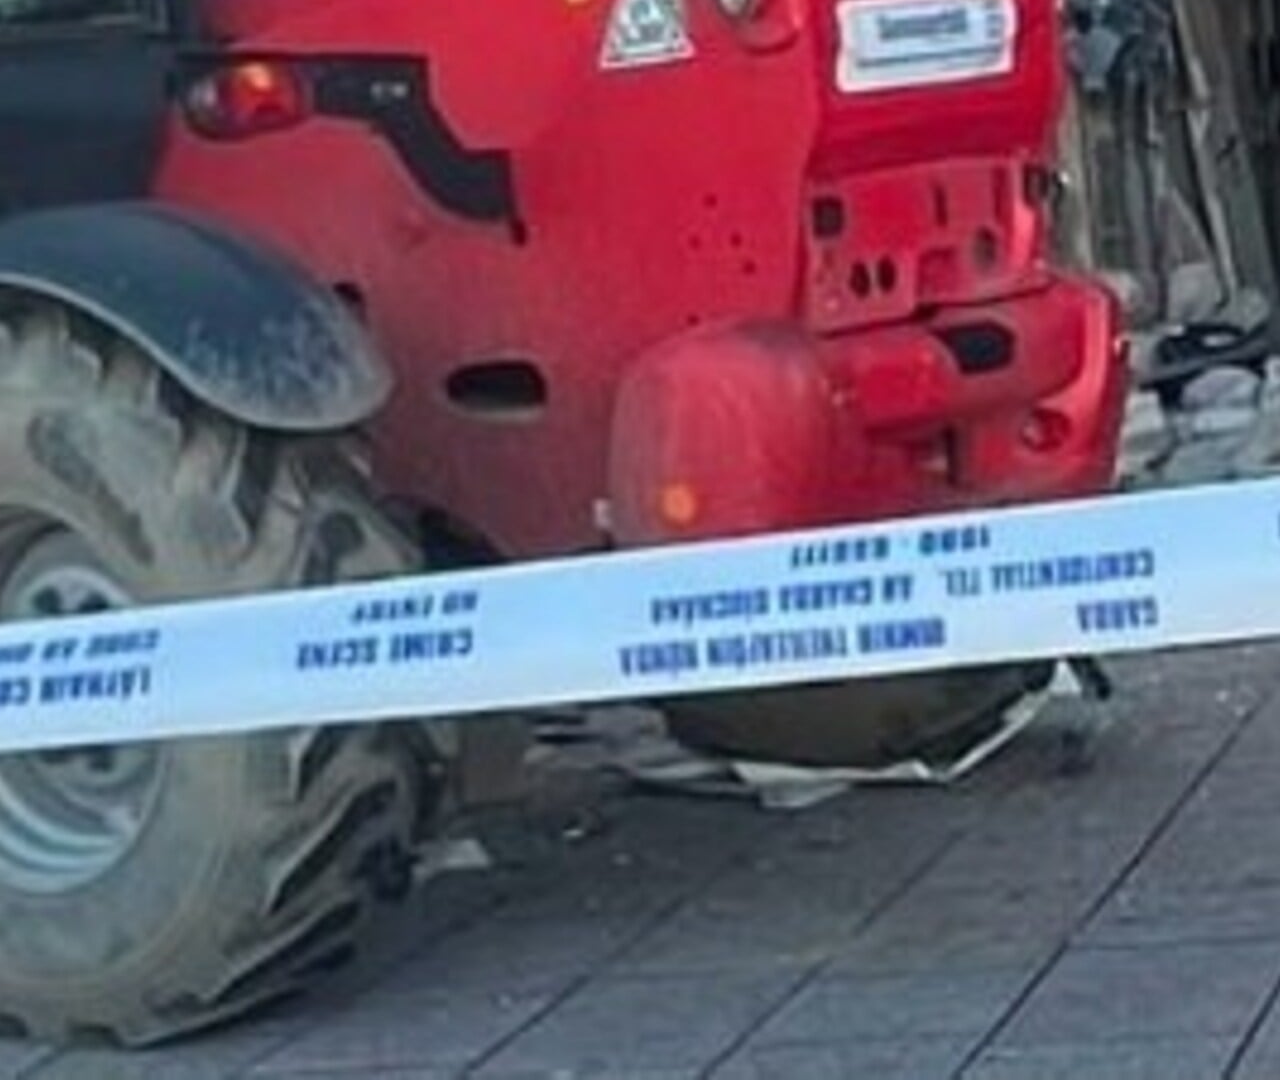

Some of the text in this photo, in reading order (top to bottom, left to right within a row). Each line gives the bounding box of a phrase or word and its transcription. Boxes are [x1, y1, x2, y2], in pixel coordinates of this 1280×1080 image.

[990, 549, 1154, 594] CONFIDENTIAL
[351, 591, 477, 624] NO ENTRY
[1076, 597, 1158, 632] GARDA
[296, 629, 473, 671] CRIME SCENE
[39, 666, 151, 706] LÁTHAIR
